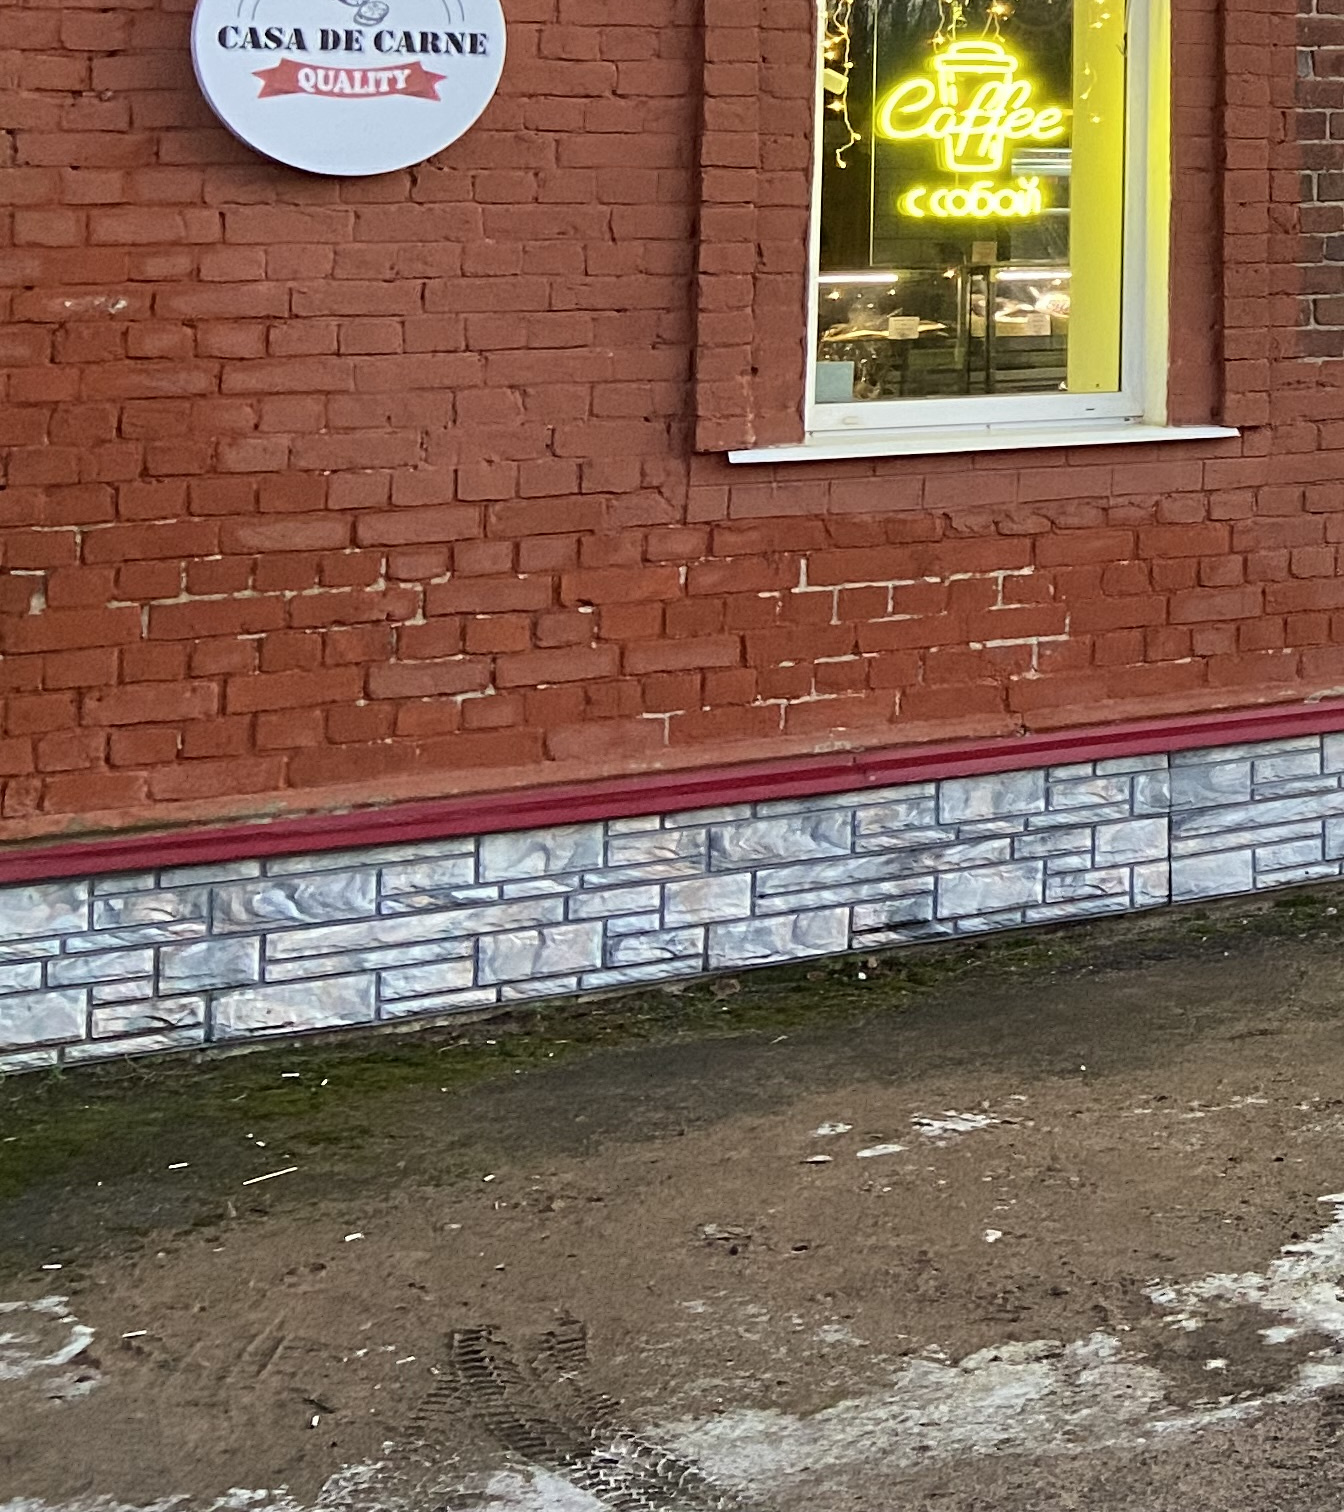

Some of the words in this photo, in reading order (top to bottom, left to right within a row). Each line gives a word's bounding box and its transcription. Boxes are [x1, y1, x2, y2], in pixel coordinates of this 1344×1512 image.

[217, 25, 306, 51] CASA
[319, 28, 363, 52] DE
[373, 29, 489, 55] CARNE
[297, 67, 412, 94] QUALITY
[878, 78, 1066, 159] Coffee
[929, 176, 1042, 218] собой
